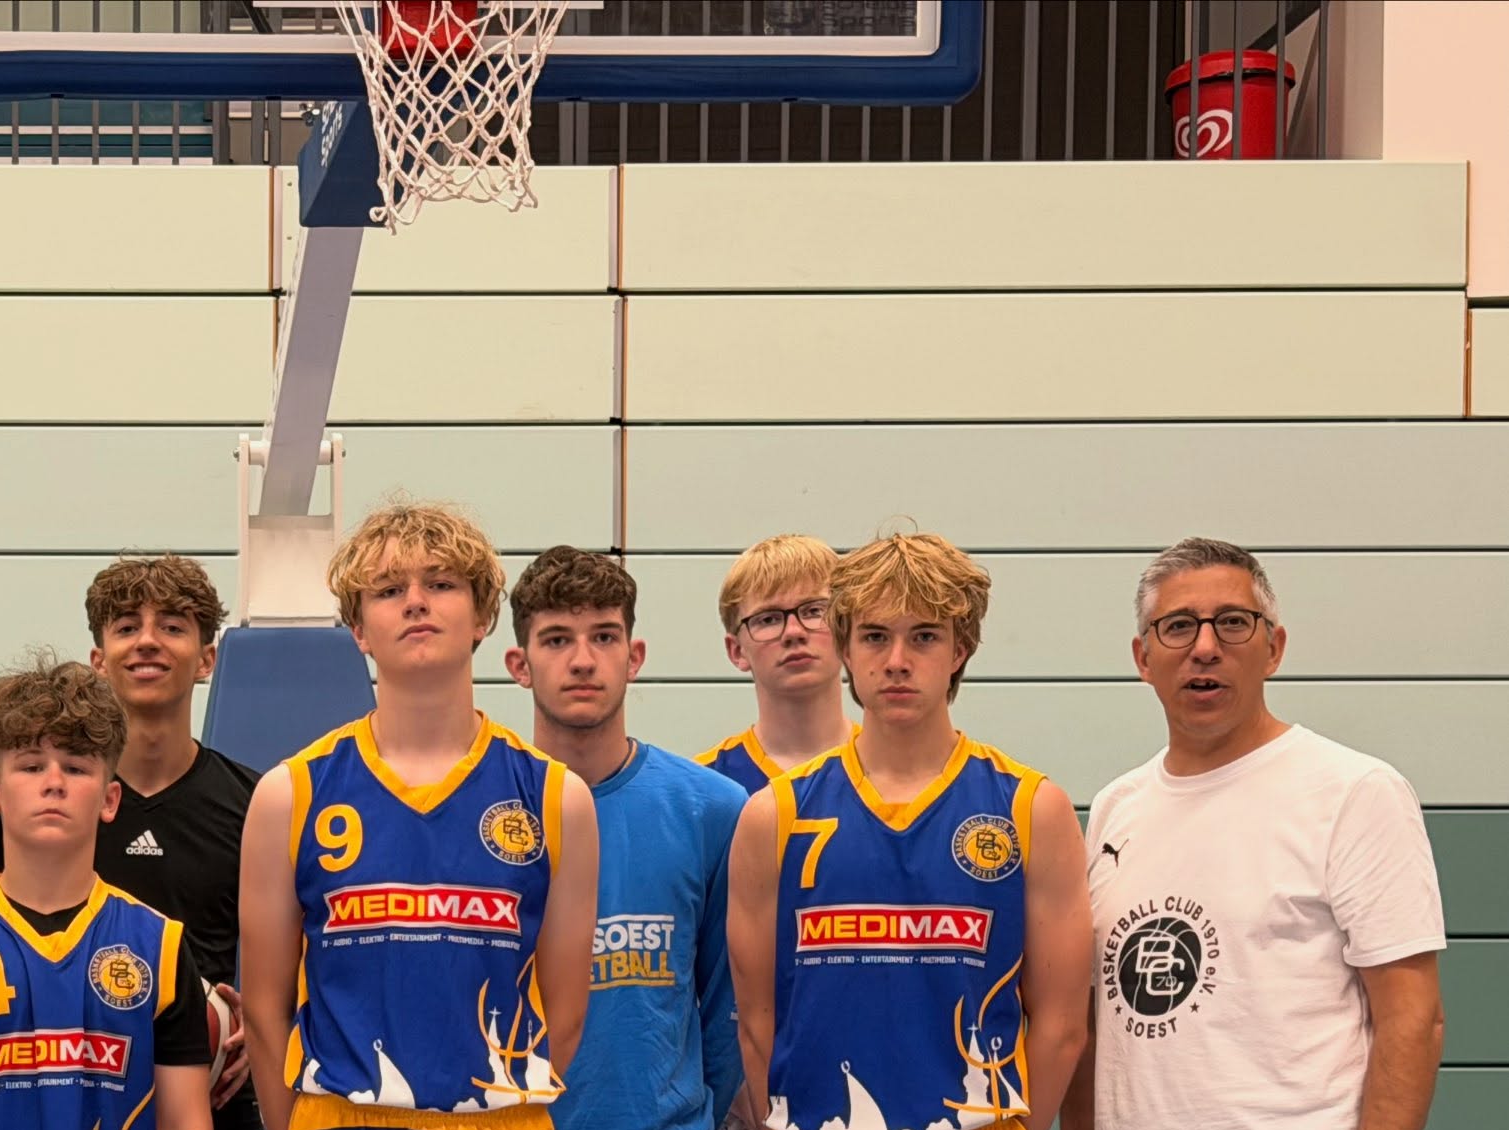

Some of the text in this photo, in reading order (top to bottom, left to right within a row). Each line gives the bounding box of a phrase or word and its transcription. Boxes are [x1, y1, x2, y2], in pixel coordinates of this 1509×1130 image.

[126, 847, 163, 856] adidas
[315, 803, 363, 872] 9
[790, 818, 838, 889] 7
[331, 894, 516, 924] MEDIMAX
[592, 923, 675, 954] SOEST
[802, 915, 982, 942] MEDIMAX
[1103, 896, 1220, 1000] BASKETBALL CLUB 1970 e.V.
[590, 951, 675, 982] TBALL
[1125, 1017, 1178, 1039] SOEST
